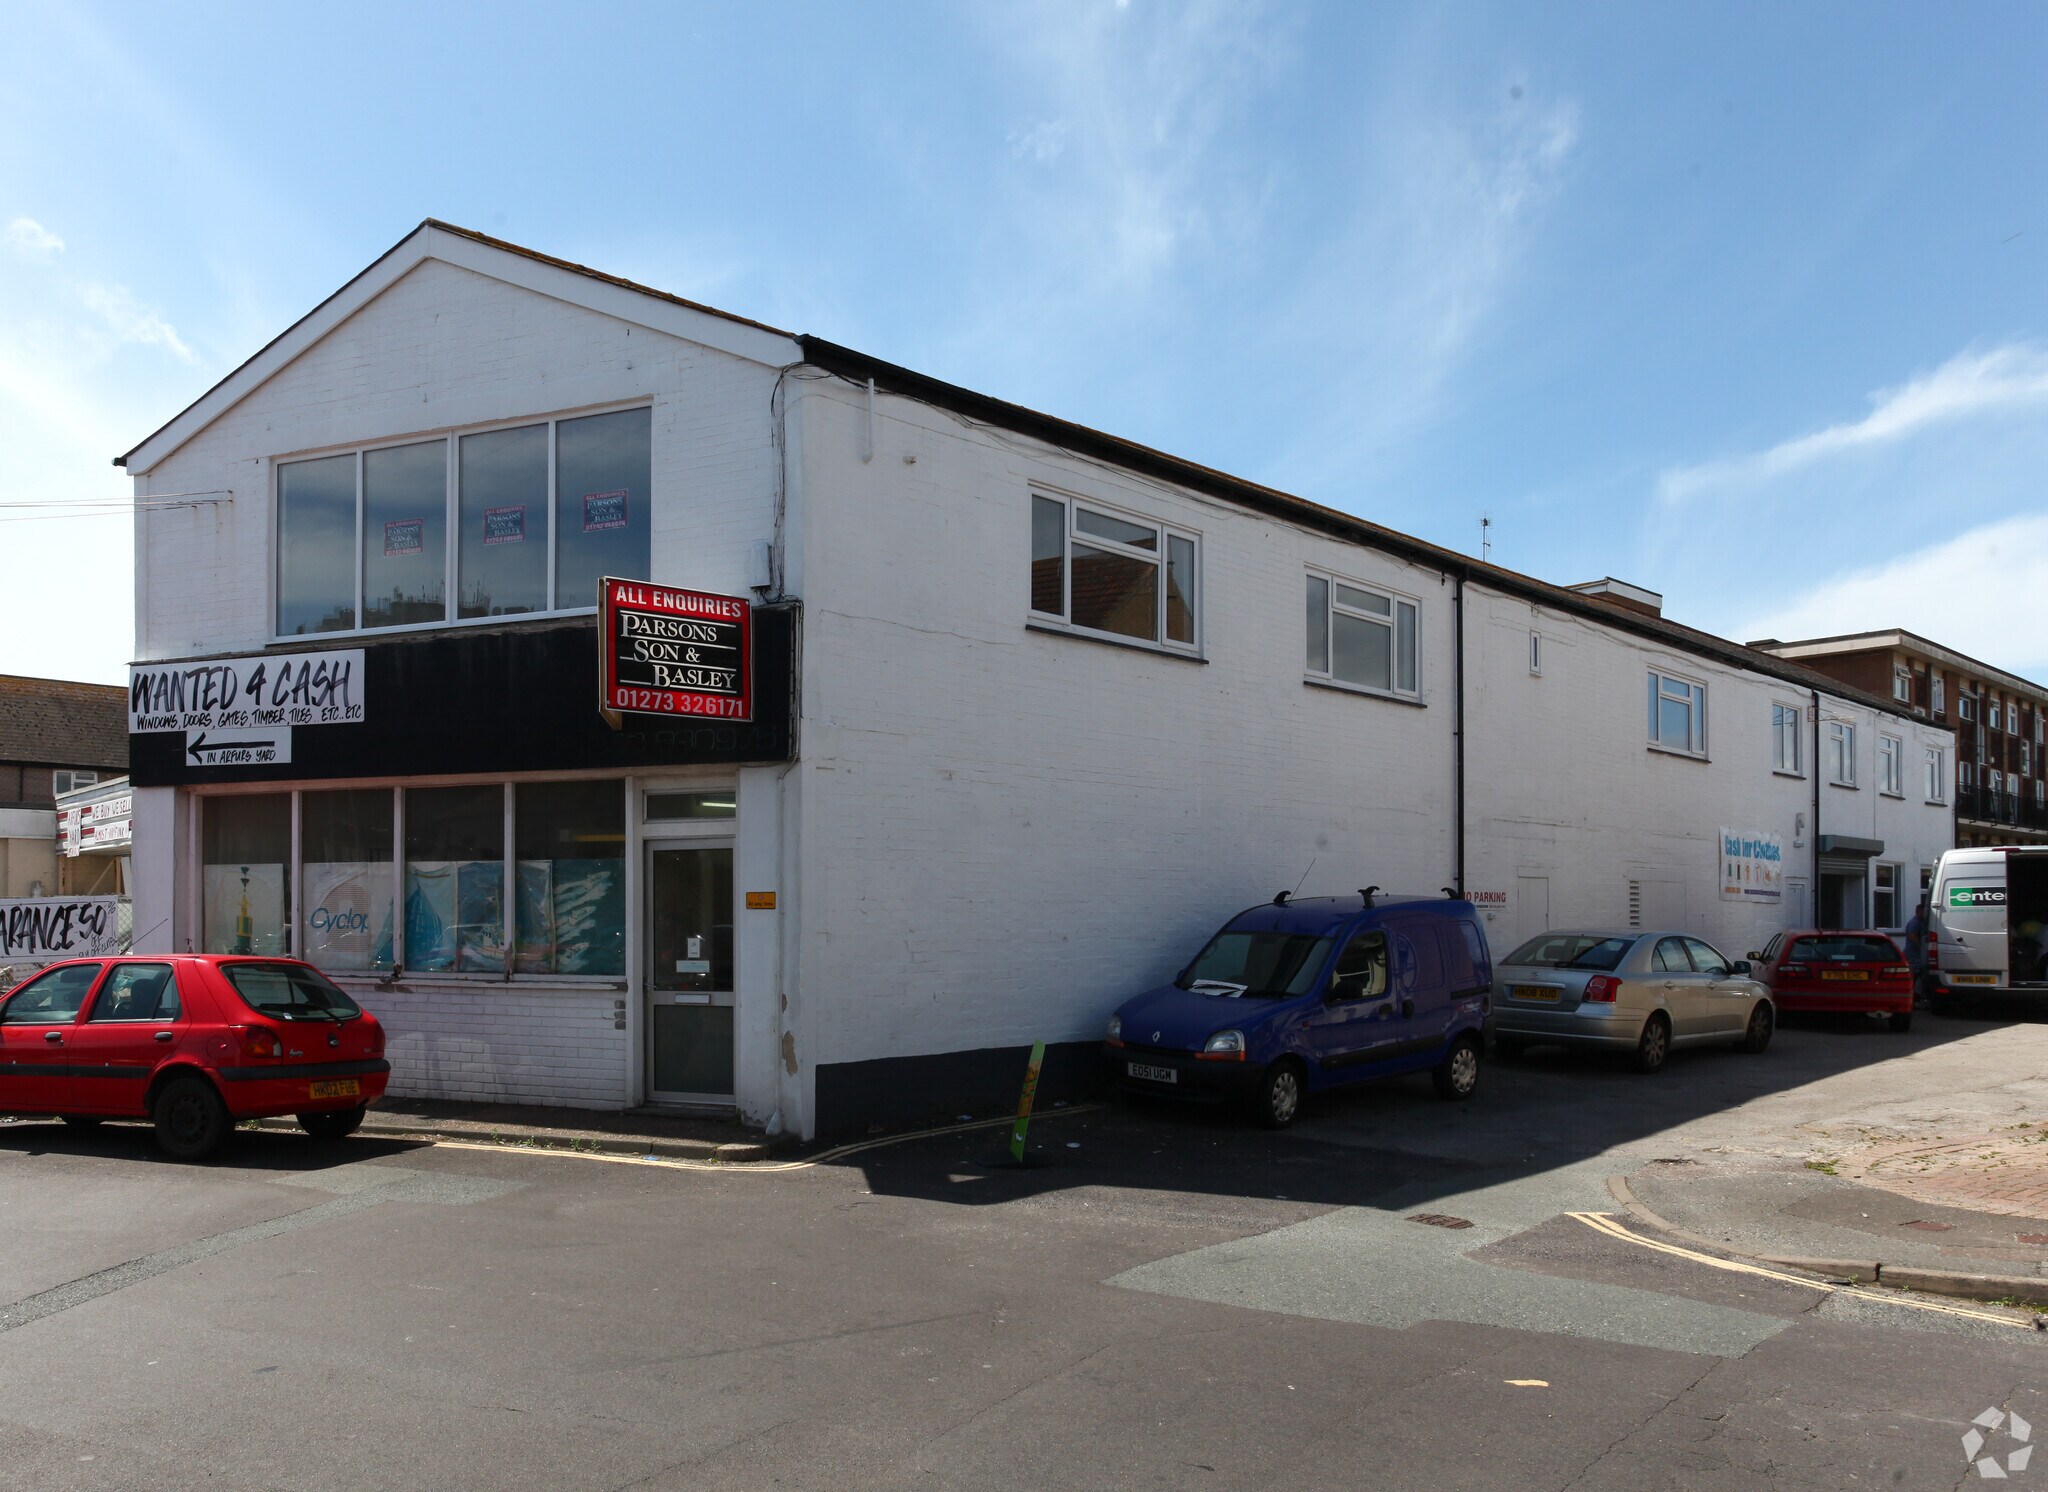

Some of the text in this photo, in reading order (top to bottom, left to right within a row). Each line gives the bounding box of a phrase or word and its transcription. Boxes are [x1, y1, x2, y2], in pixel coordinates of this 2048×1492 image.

[616, 586, 742, 618] ALL ENQUIRIES
[620, 614, 717, 642] PARSONS
[633, 639, 701, 663] SON &
[132, 659, 351, 714] WANTED 4 CASH
[653, 664, 736, 689] BASLEY
[616, 688, 743, 717] 01273 326171
[206, 749, 276, 763] IN ARFURS YARD
[1725, 835, 1741, 857] Cash
[1474, 891, 1506, 903] PARKING
